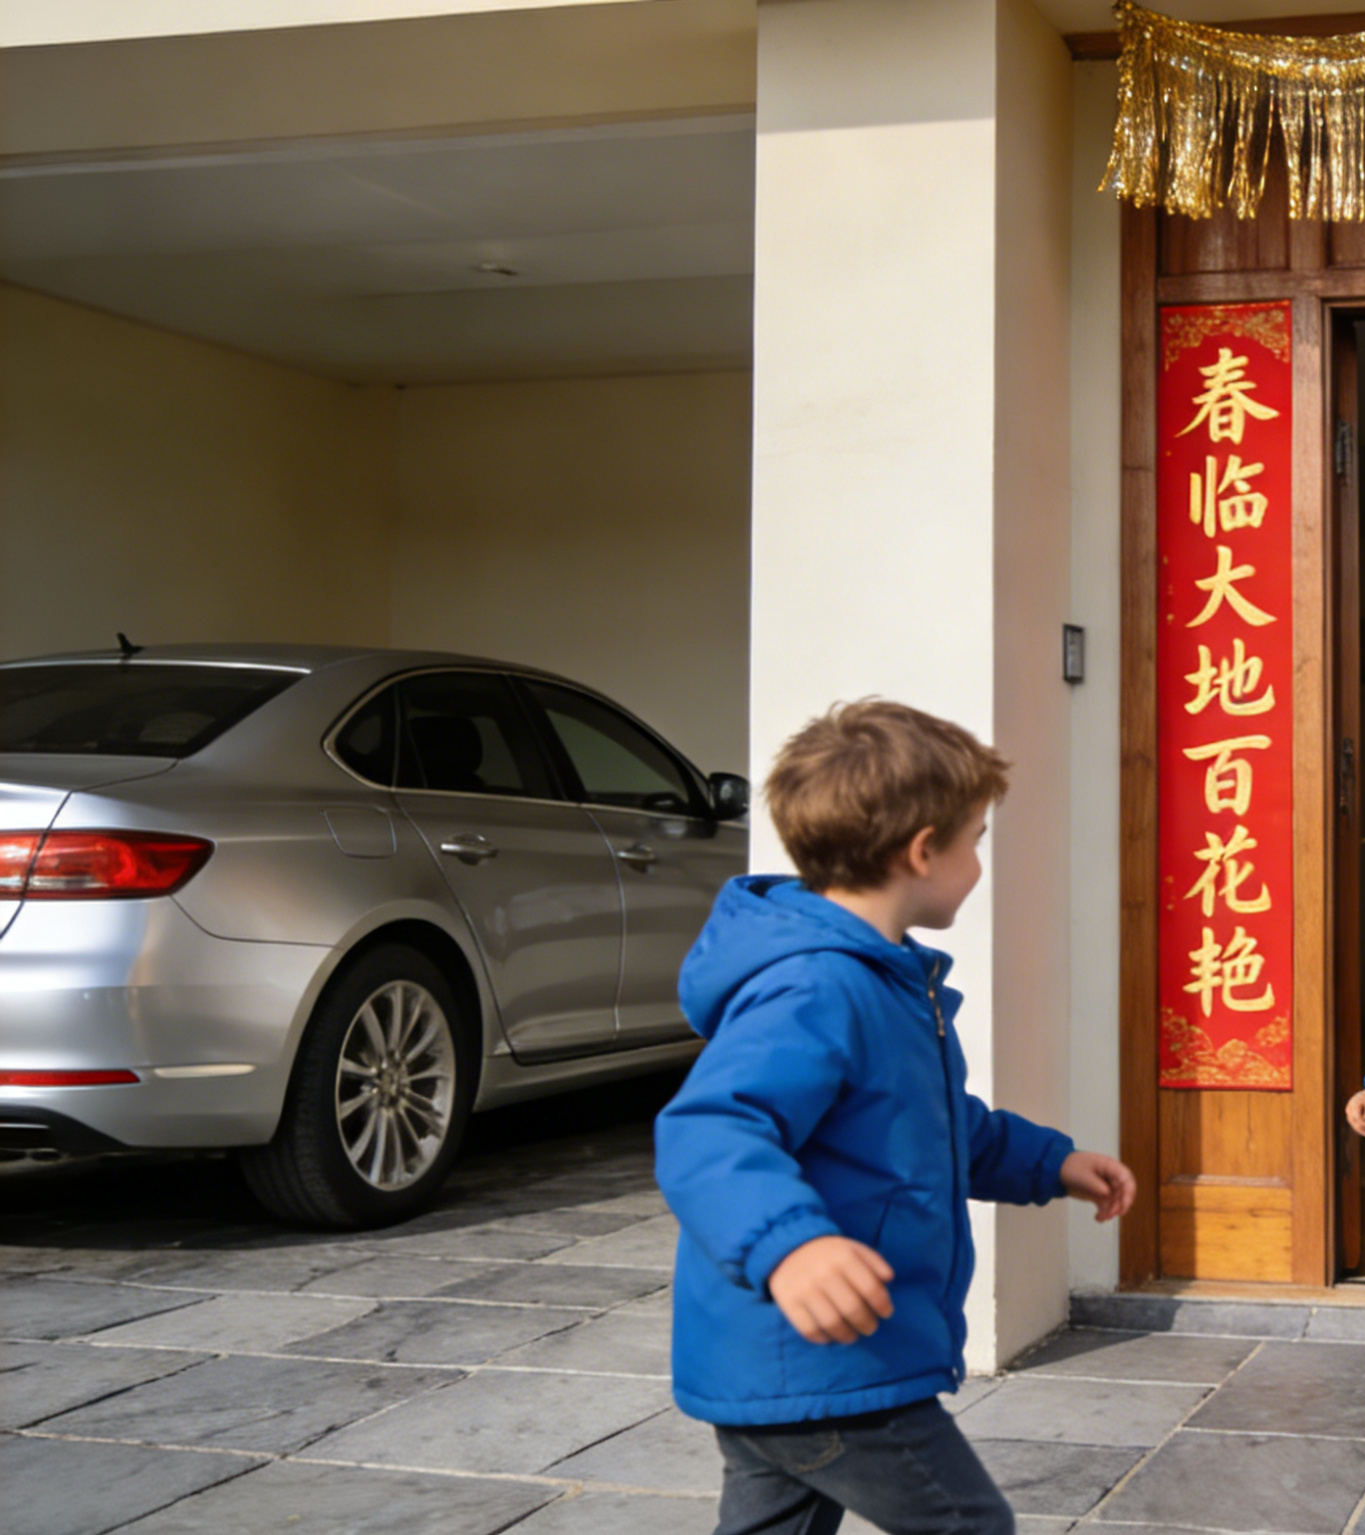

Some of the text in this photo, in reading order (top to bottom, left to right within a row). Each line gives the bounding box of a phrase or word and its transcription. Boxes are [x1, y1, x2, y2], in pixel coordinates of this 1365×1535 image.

[1174, 347, 1280, 1018] 春临大地百花艳
